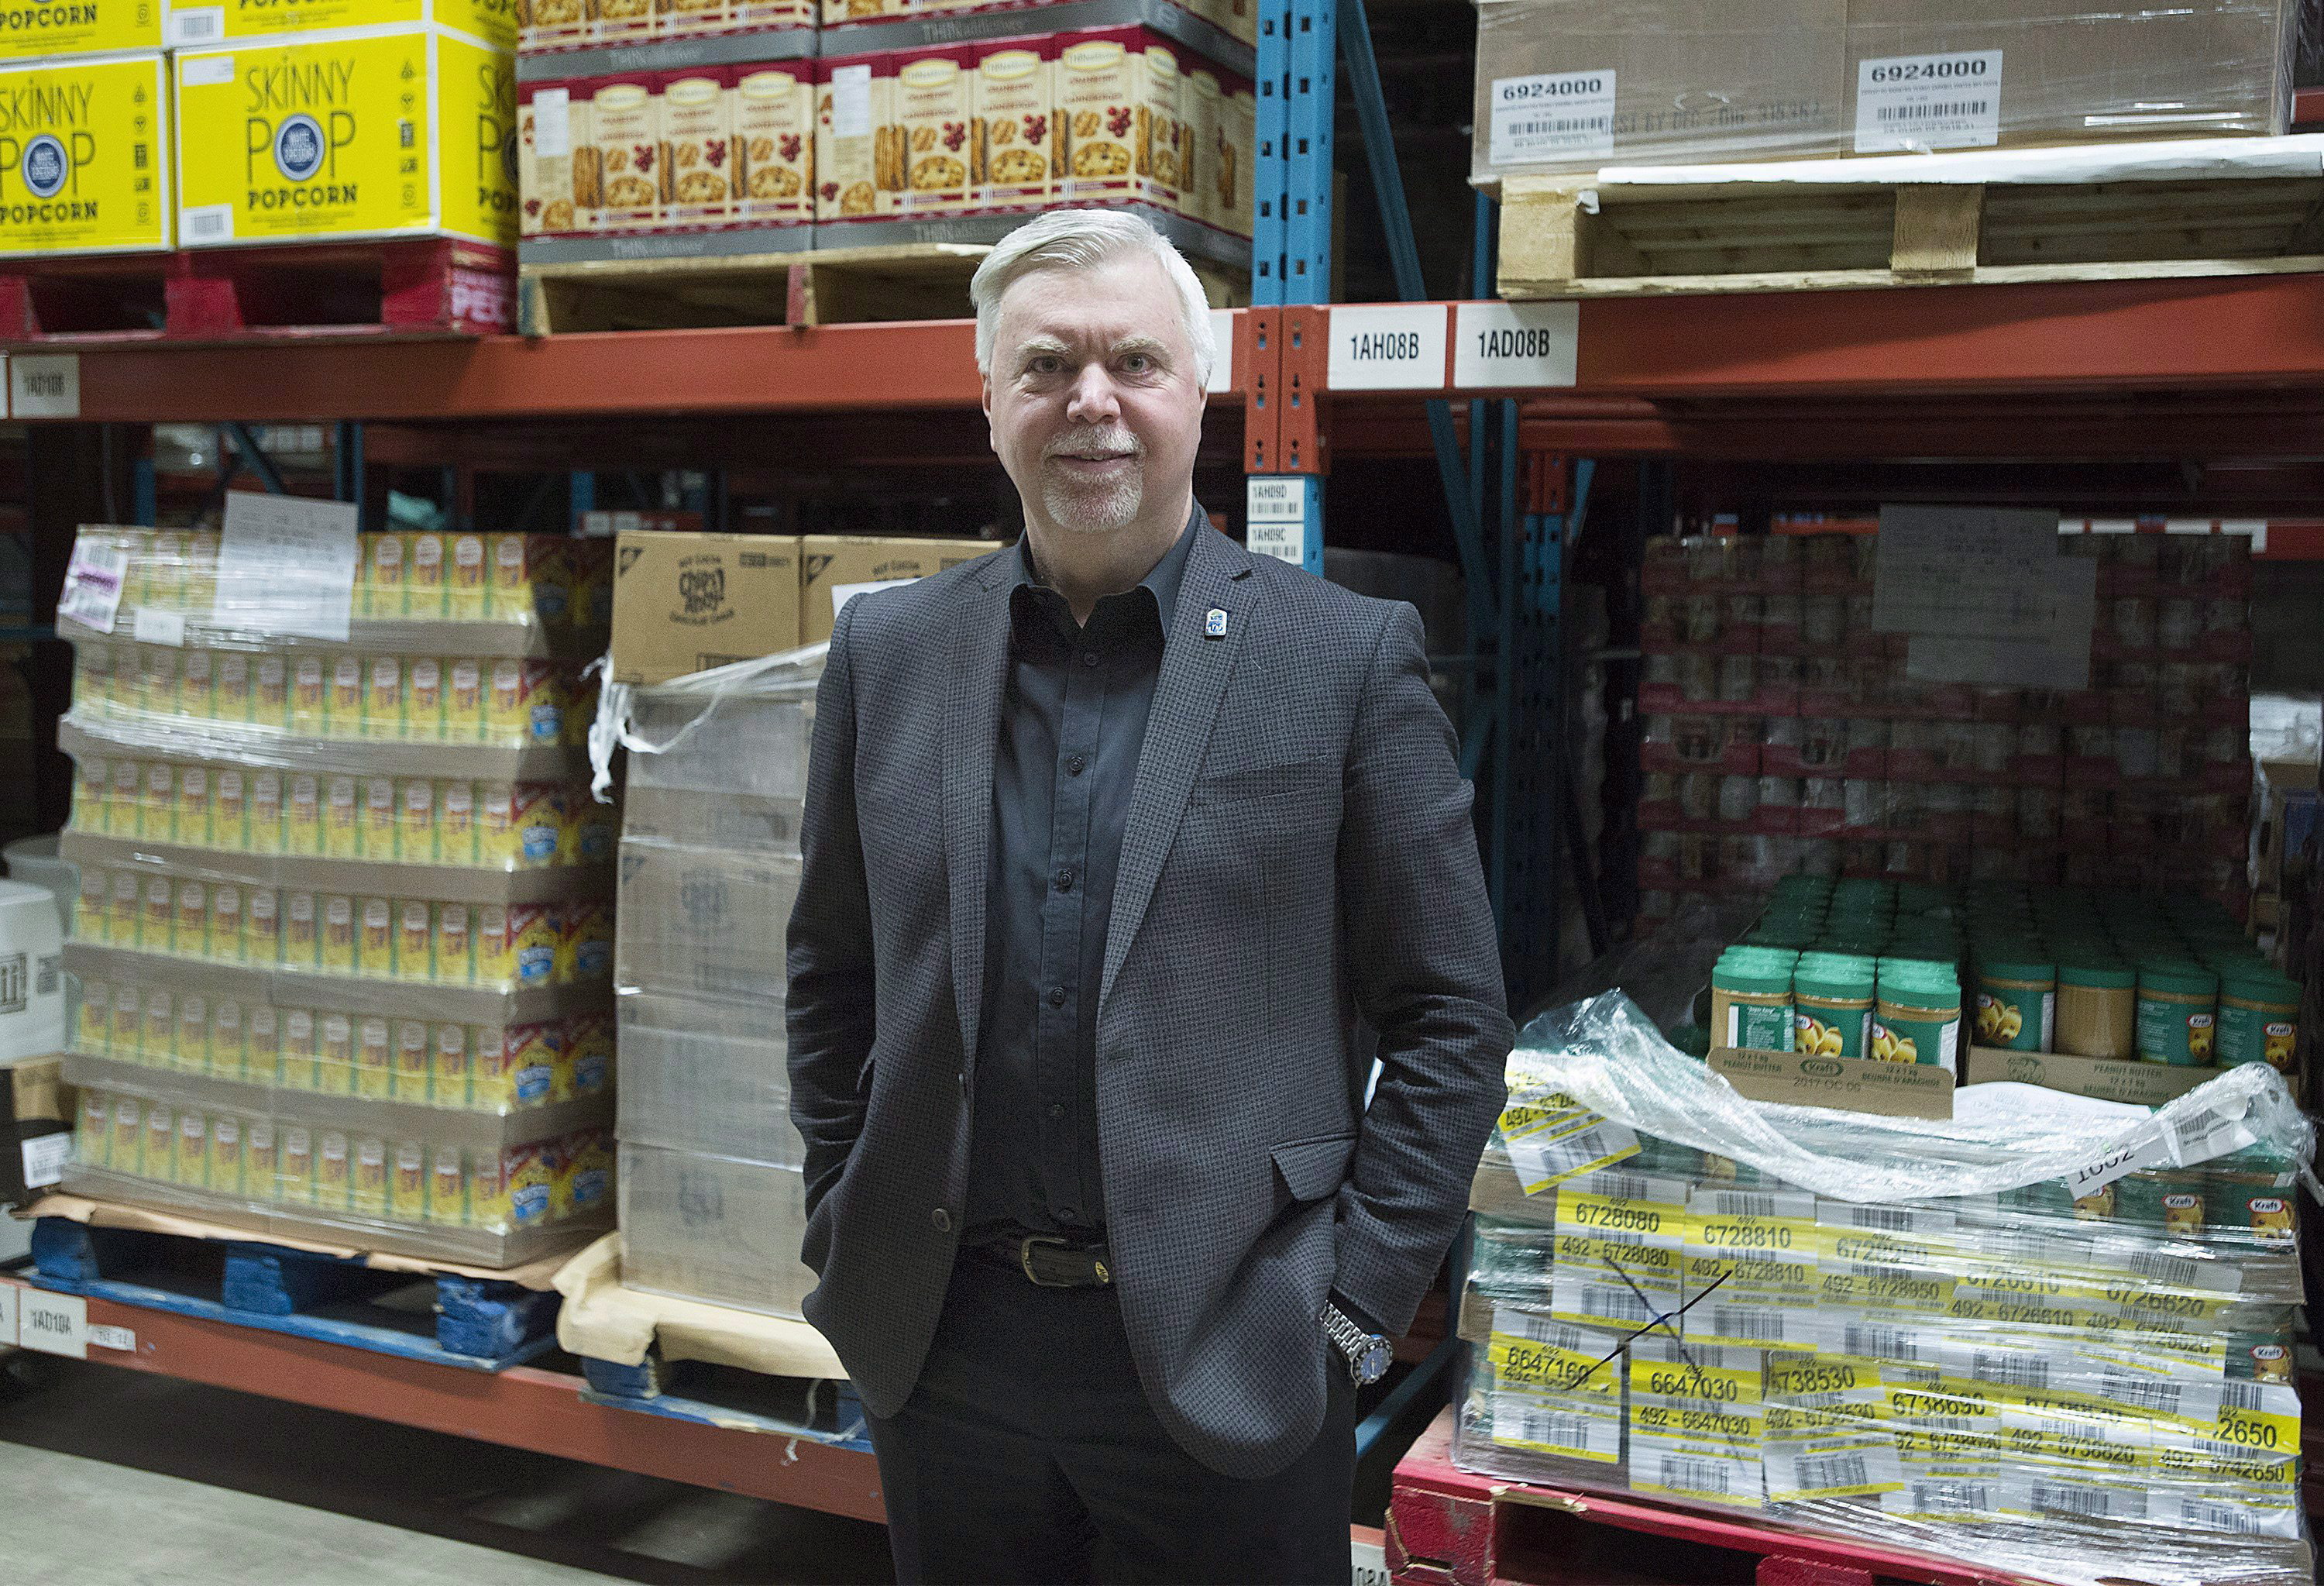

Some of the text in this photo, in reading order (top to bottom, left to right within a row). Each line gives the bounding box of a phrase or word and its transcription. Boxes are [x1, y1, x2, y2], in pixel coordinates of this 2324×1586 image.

[1871, 60, 1986, 82] 6924000
[1503, 78, 1601, 101] 6924000
[249, 184, 357, 211] POPCORN
[0, 201, 98, 225] POPCORN
[1351, 332, 1419, 360] 1AH08B
[1478, 329, 1550, 358] 1AD08B
[1723, 1058, 1783, 1073] PEANUT BUTTER
[1810, 1061, 1834, 1072] Kraft
[2093, 1063, 2162, 1078] PEANUT BUTTER
[1793, 1075, 1820, 1088] 2017
[1824, 1079, 1843, 1091] OC
[1862, 1072, 1892, 1082] BEURRE
[2083, 1085, 2118, 1096] BEURRE
[1506, 1107, 1533, 1126] 492
[2169, 1197, 2192, 1206] Kraft
[2254, 1201, 2278, 1210] Kraft
[1576, 1202, 1660, 1233] 6728080
[1704, 1224, 1792, 1248] 6728810
[1562, 1236, 1590, 1256] 492
[1603, 1242, 1669, 1267] 6728080
[1691, 1258, 1805, 1282] 492 6728810
[1823, 1275, 1853, 1294] 492
[1951, 1299, 1983, 1319] 492
[1508, 1346, 1589, 1381] 6647160
[2257, 1348, 2280, 1357] Kraft
[1651, 1372, 1738, 1402] 6647030
[1639, 1406, 1668, 1426] 492
[1682, 1411, 1751, 1436] 6647030
[1766, 1409, 1794, 1429] 492
[1895, 1431, 1915, 1450] 92
[2010, 1428, 2043, 1450] 492
[2213, 1418, 2277, 1448] 2650
